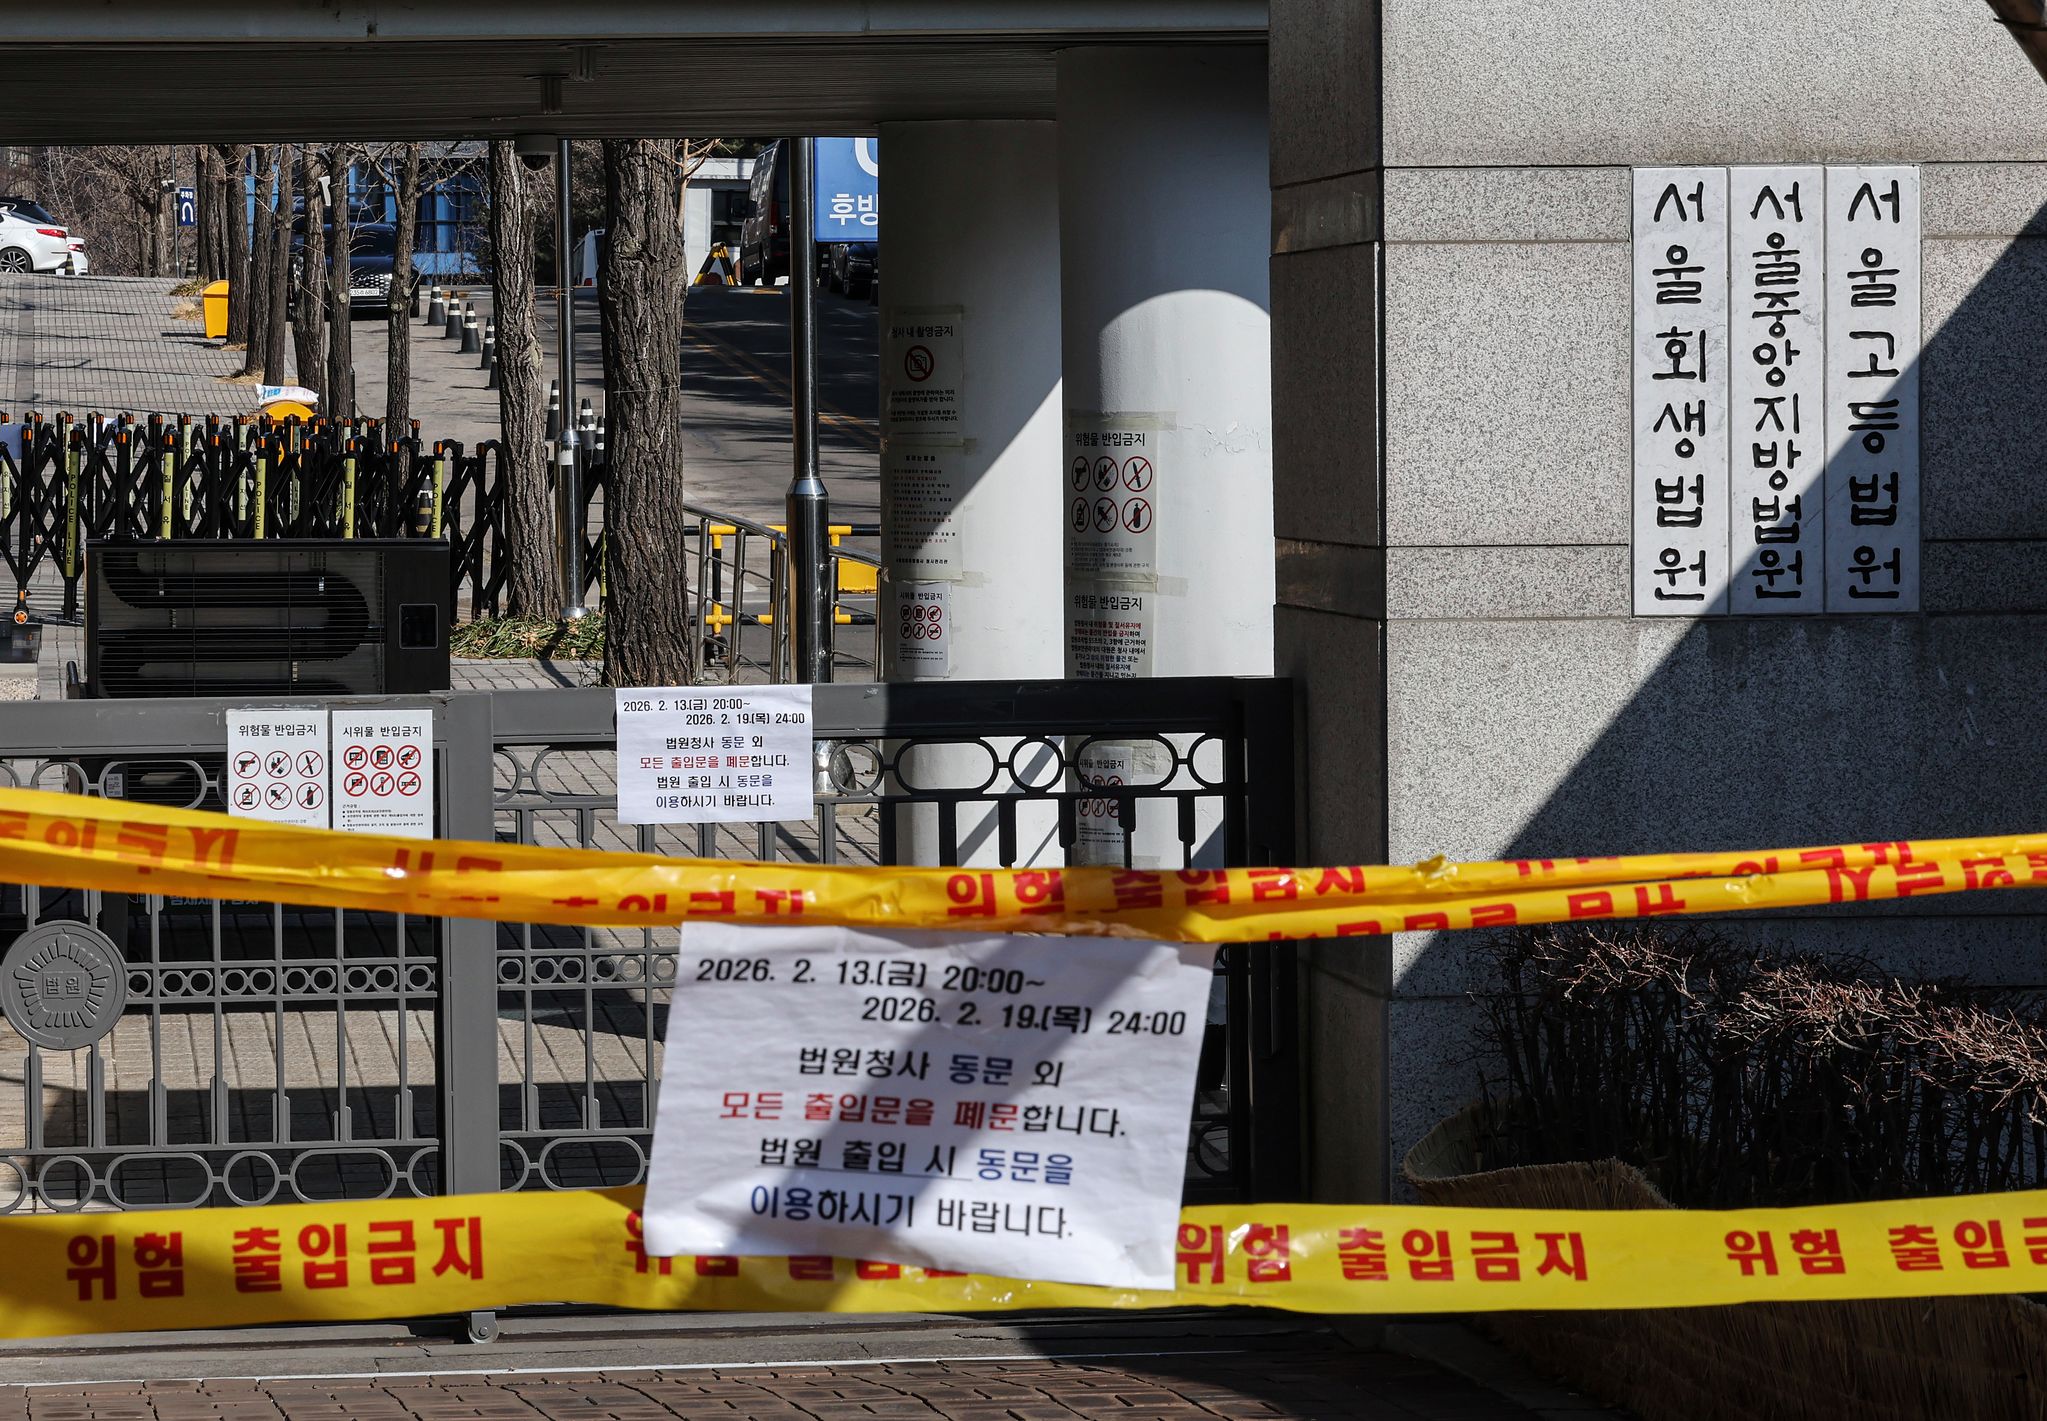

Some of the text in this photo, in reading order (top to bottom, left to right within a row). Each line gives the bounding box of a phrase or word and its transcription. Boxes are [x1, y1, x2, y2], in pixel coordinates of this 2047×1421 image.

[1652, 182, 1707, 601] 서울회생법원
[1750, 181, 1803, 600] 서울중앙지방법원
[1848, 180, 1901, 599] 서울고등법원
[1102, 433, 1145, 446] 반입금지
[68, 474, 76, 523] POLICE
[918, 592, 943, 600] 반입금지
[1100, 596, 1142, 611] 반입금지
[624, 698, 751, 712] 2026. 2. 13.(금) 20:00~
[686, 713, 805, 725] 2026. 2. 19.(목) 24:00
[238, 724, 317, 736] 위험물 반입금지
[343, 725, 422, 738] 시위물 반입금지
[666, 735, 764, 750] 법원청사 동문 외
[640, 754, 790, 770] 모든 출입문을 폐문합니다.
[657, 774, 773, 789] 법원 출입 시 동문을
[656, 794, 775, 809] 이용하시기 바랍니다.
[46, 976, 81, 994] 법원
[696, 959, 1046, 995] 2026. 2. 13.(금) 20:00~
[861, 997, 1187, 1036] 2026. 2. 19.(목) 24:00
[799, 1047, 1063, 1087] 법원청사 동문 외
[719, 1091, 1127, 1138] 모든 출입문을 폐문합니다.
[760, 1138, 1075, 1186] 법원 출입 시 동문을
[750, 1186, 1073, 1239] 이용하시기 바랍니다.
[67, 1217, 484, 1301] 위험 출입금지
[1176, 1223, 1588, 1284] 위험 출입금지
[1724, 1229, 1846, 1276] 위험
